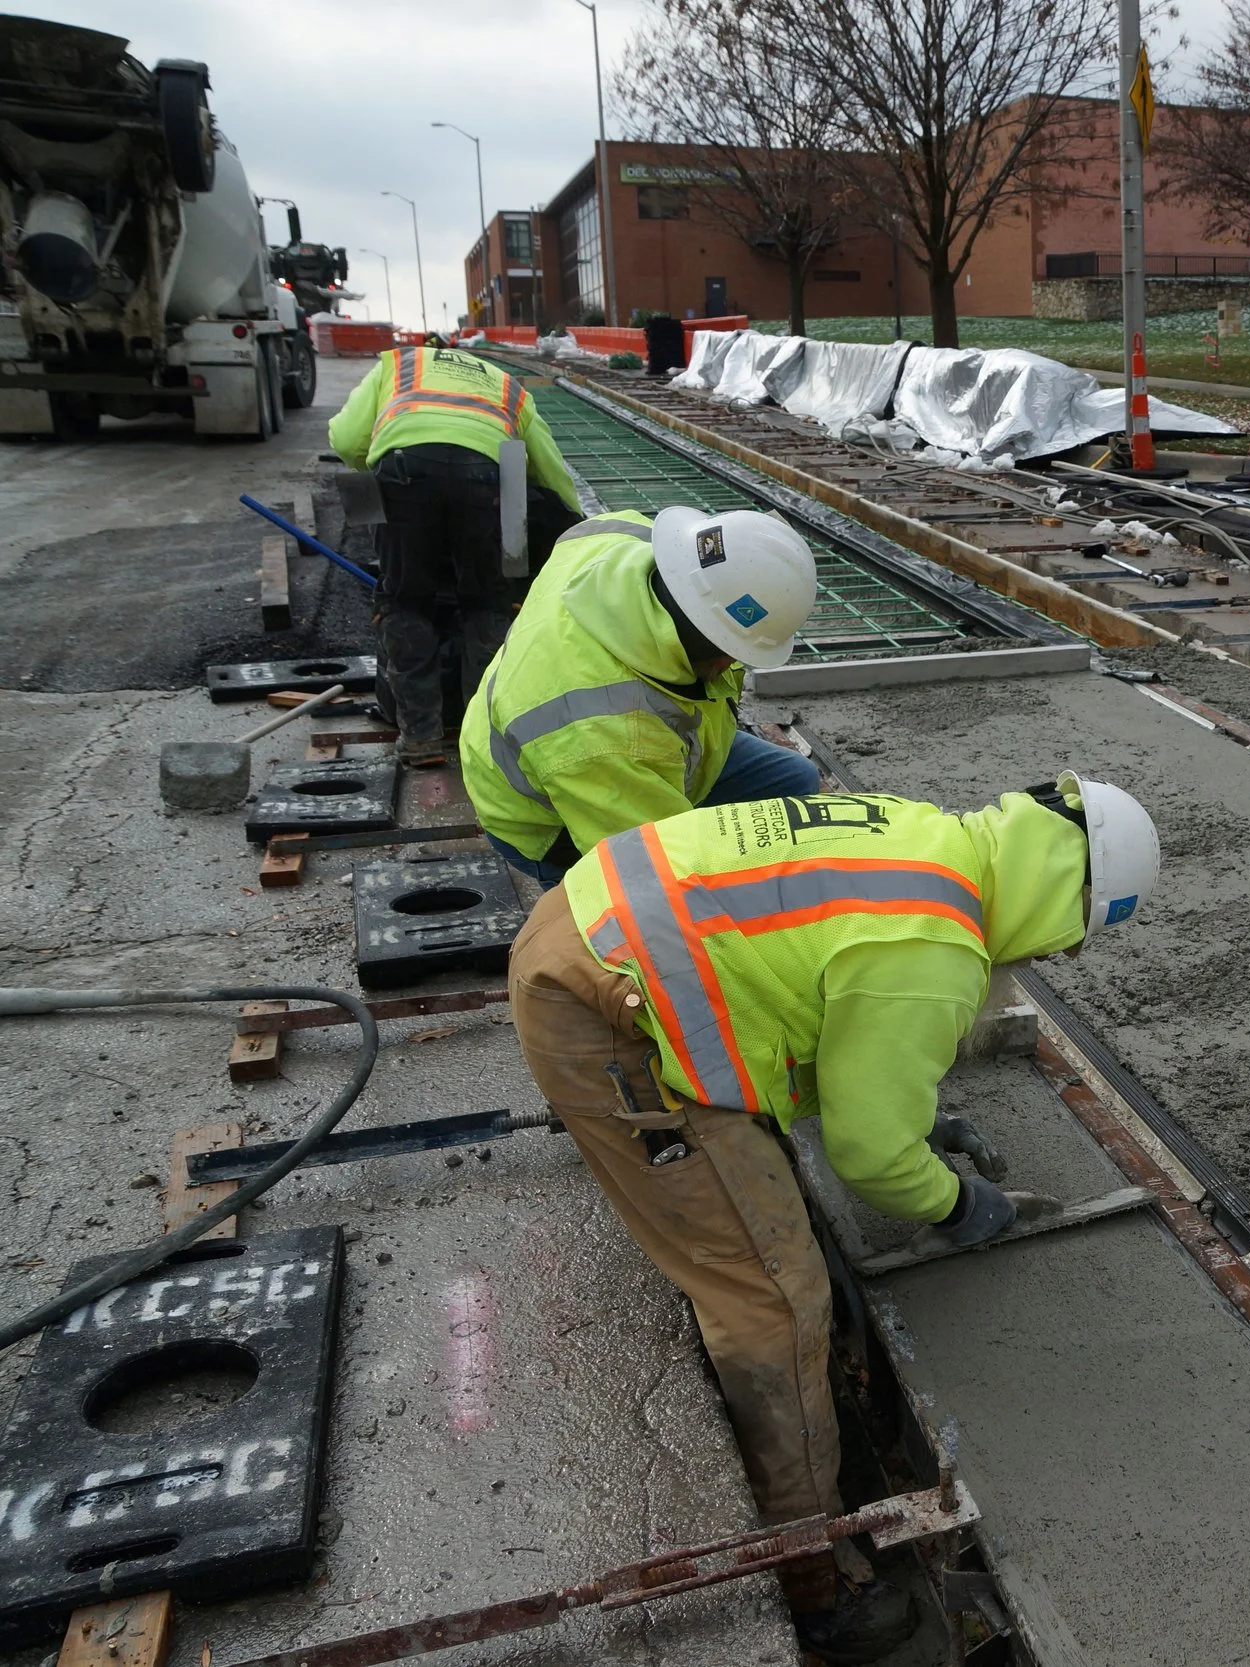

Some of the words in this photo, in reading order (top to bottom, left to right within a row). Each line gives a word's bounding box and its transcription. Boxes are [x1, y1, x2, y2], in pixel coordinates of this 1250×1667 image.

[733, 821, 742, 832] and
[767, 800, 788, 841] STREETCAR
[63, 1261, 322, 1335] KCSC
